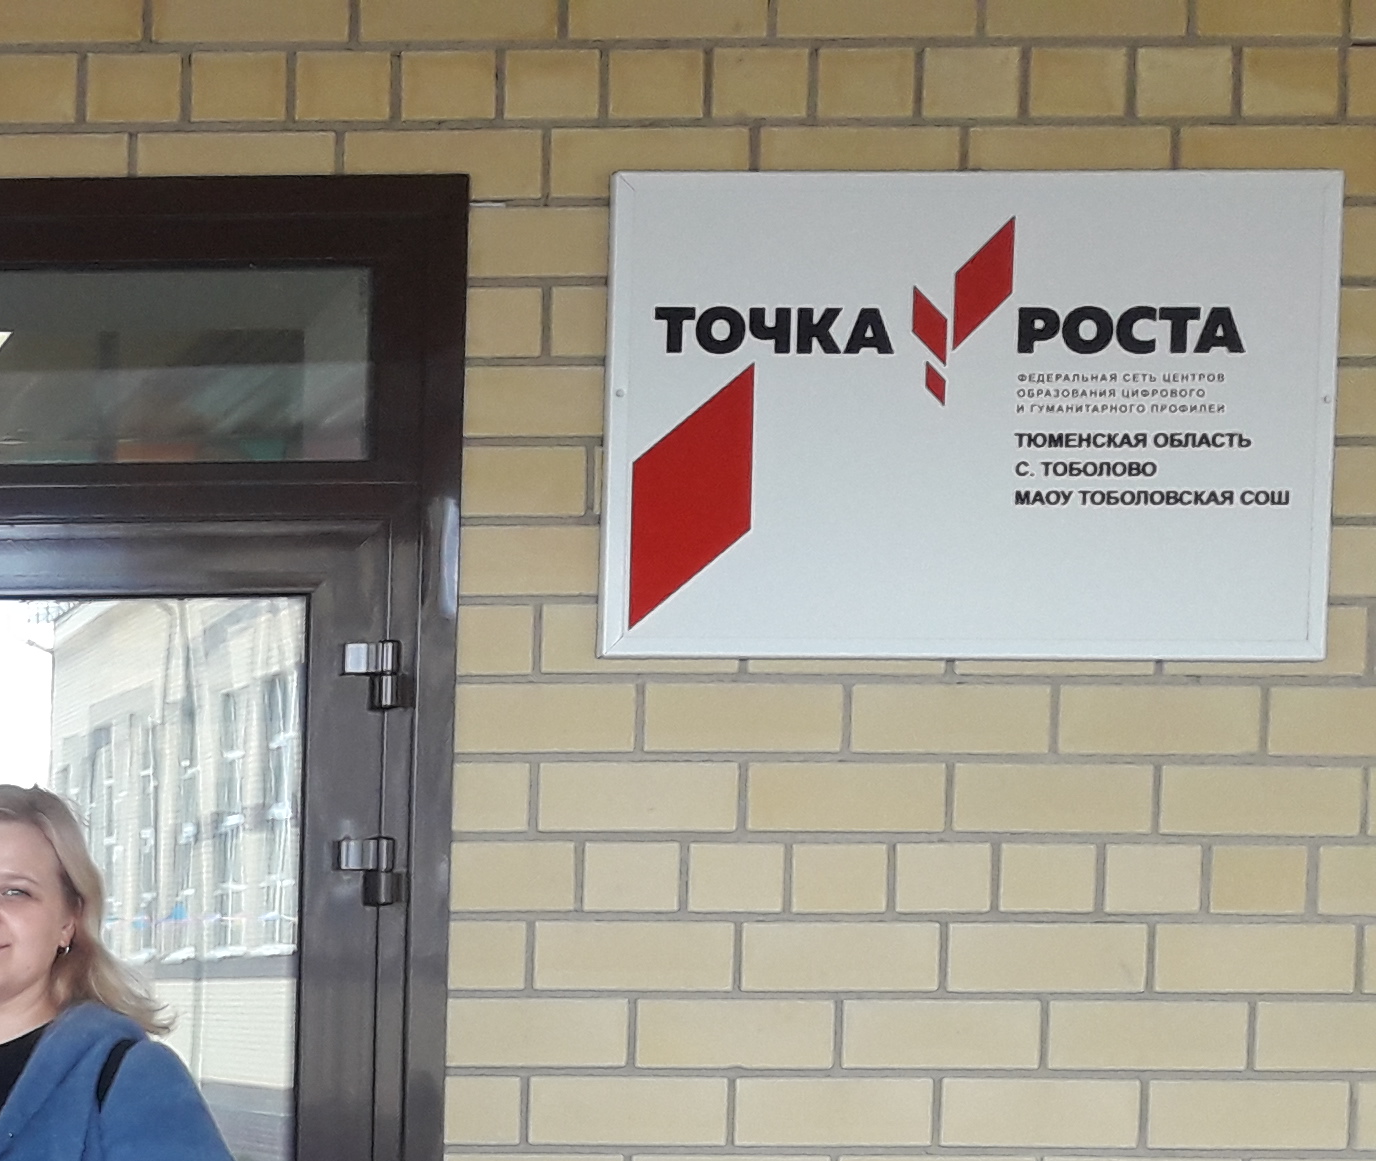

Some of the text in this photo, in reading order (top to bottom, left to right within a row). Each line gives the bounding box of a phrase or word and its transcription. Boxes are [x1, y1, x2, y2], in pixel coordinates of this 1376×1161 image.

[654, 305, 1246, 355] ТОЧКА РОСТА
[1017, 372, 1226, 384] ФЕДЕРАЛЬНАЯ СЕТЬ ЦЕНТРОВ
[1016, 388, 1206, 399] ОБРАЗОВАНИЯ ЦИФРОВОГО
[1016, 403, 1025, 413] И
[1029, 403, 1147, 413] ГУМАНИТАРНОГО
[1014, 432, 1253, 449] ТЮМЕНСКАЯ ОБЛАСТЬ
[1015, 461, 1157, 477] С. ТОБОЛОВО
[1014, 490, 1290, 506] МАОУ ТОБОЛОВСКАЯ СОШ
